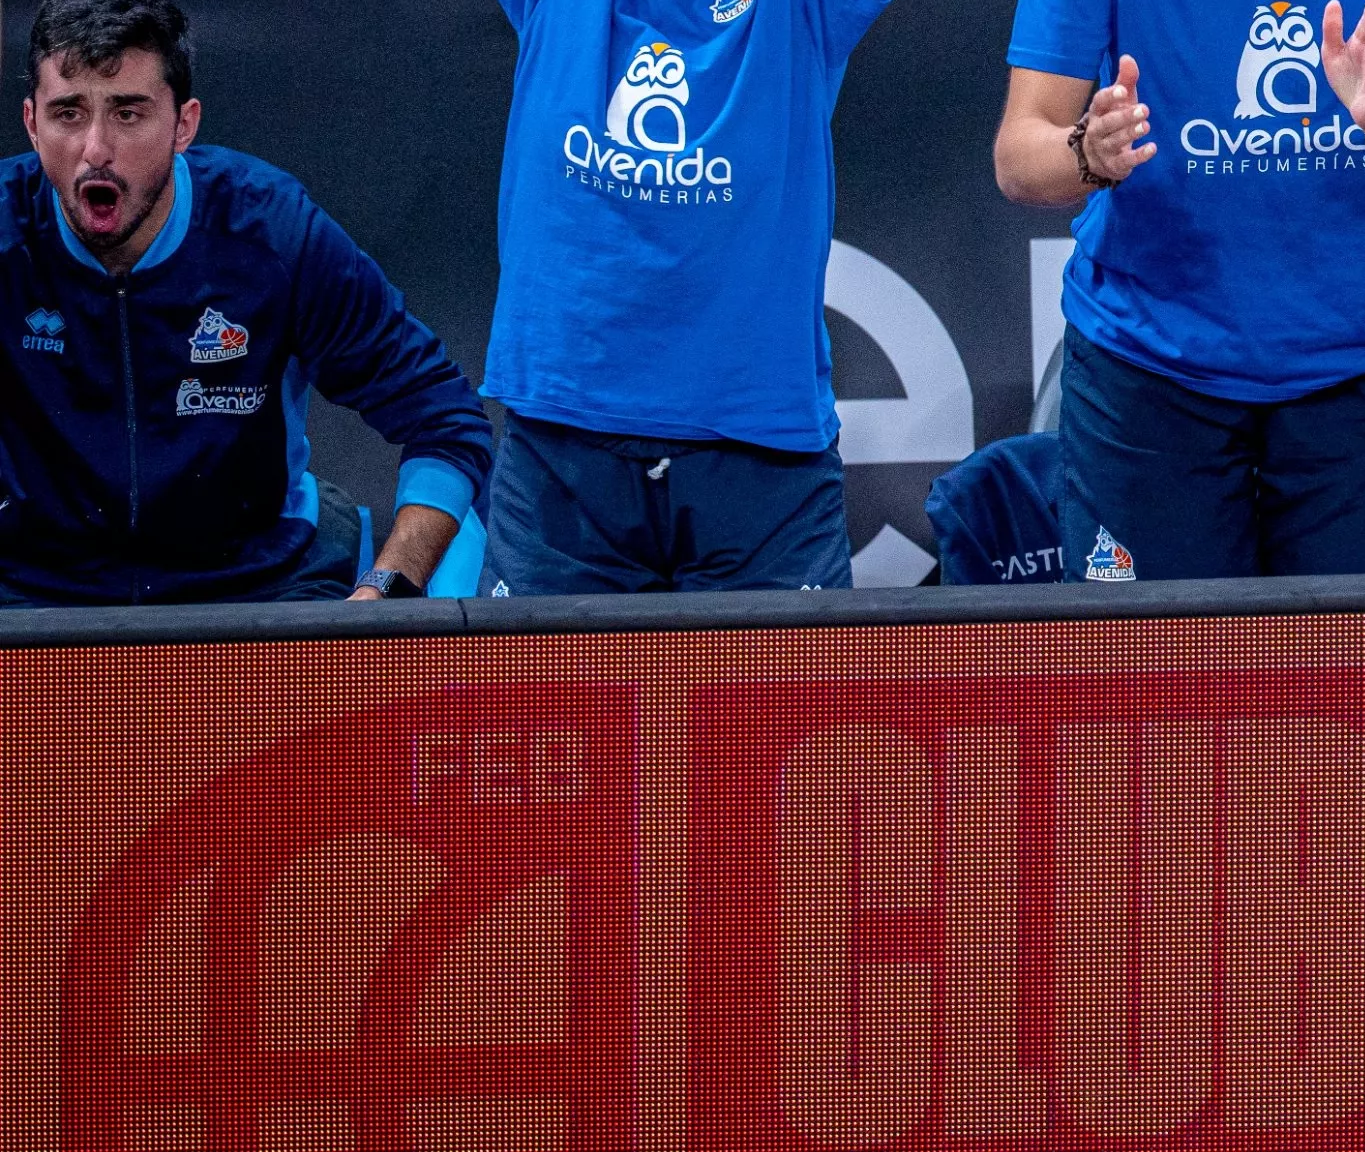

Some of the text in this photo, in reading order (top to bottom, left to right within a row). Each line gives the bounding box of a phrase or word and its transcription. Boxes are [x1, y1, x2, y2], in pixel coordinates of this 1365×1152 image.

[23, 334, 65, 354] errea
[194, 346, 246, 360] AVENIDA
[1090, 566, 1134, 578] AVENIDA
[409, 728, 590, 808] FEB
